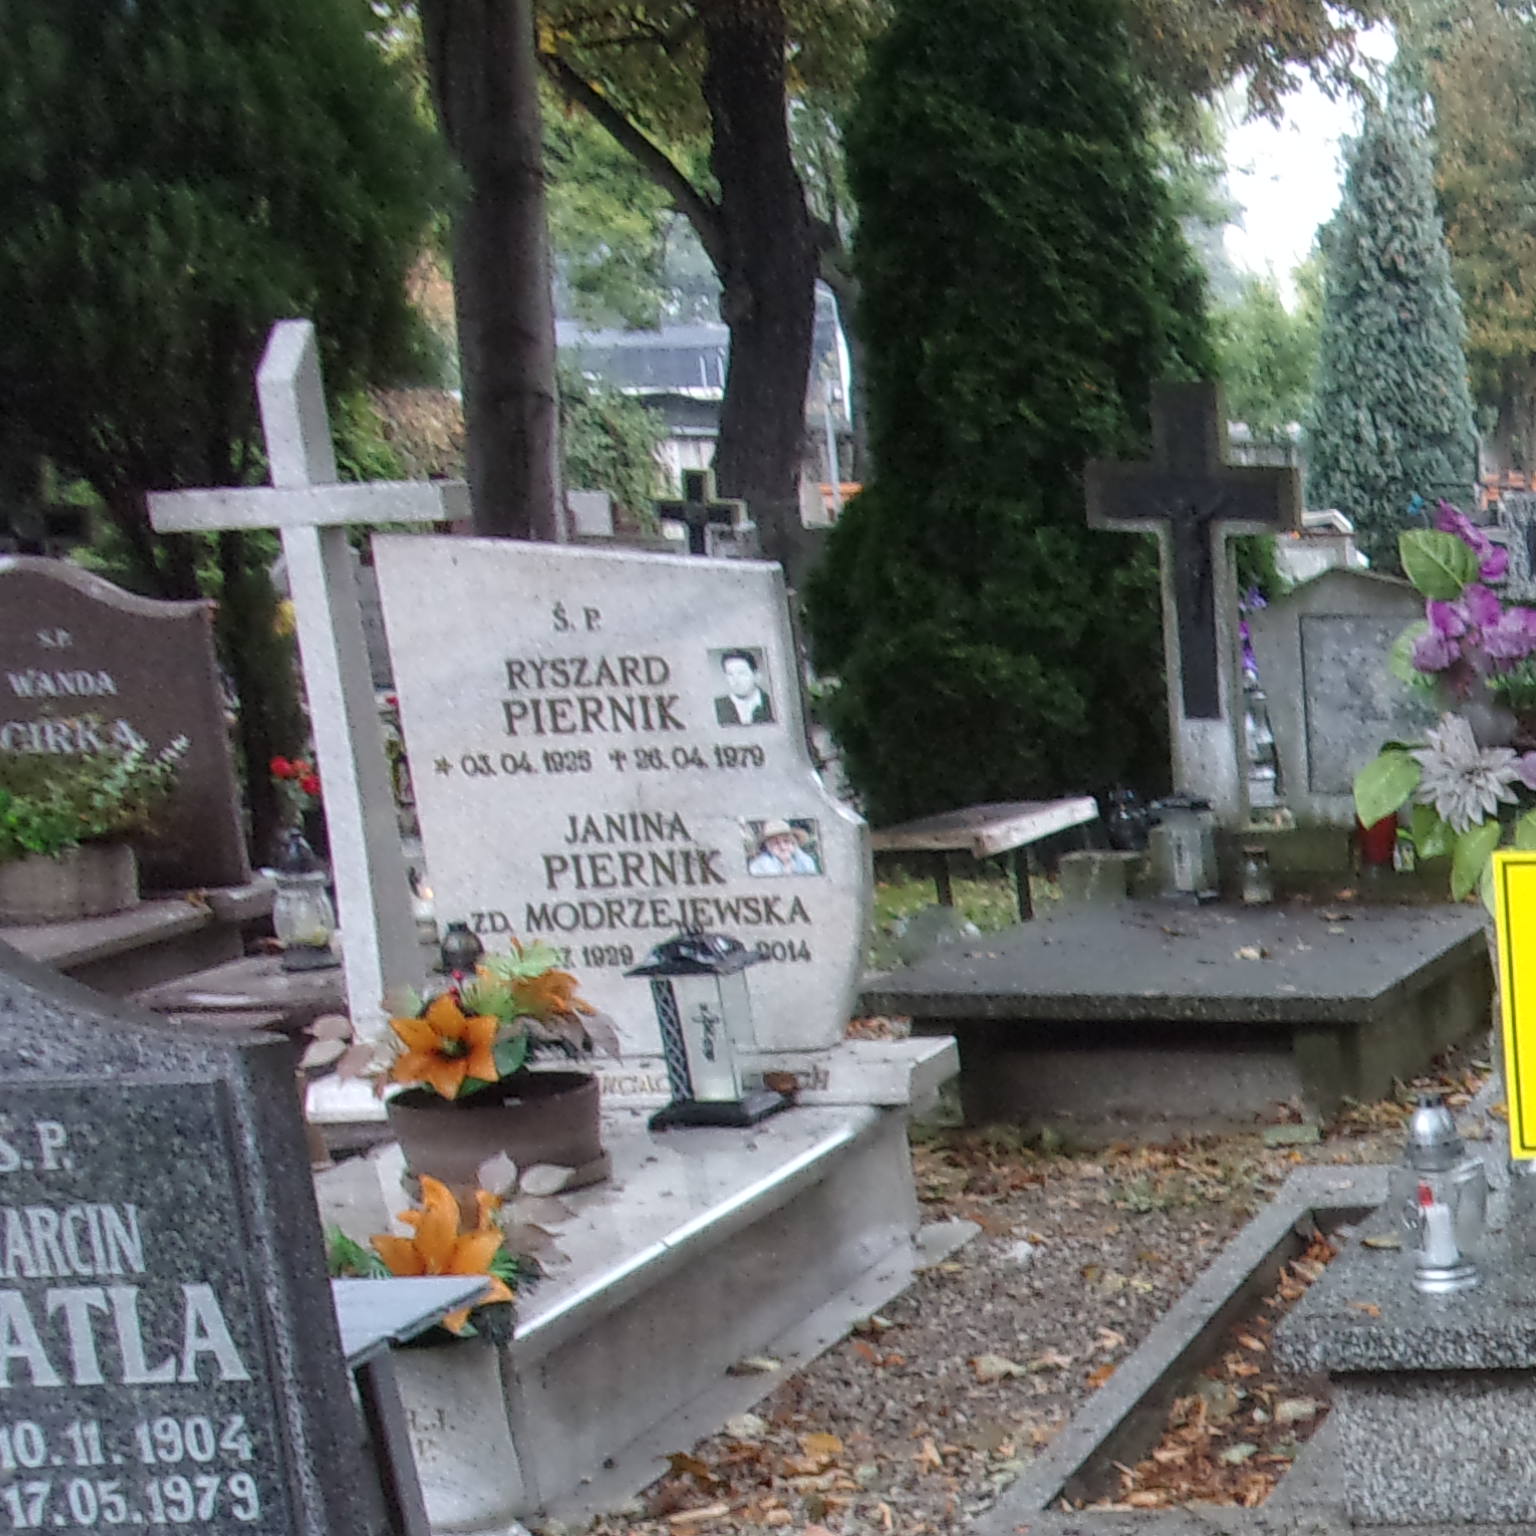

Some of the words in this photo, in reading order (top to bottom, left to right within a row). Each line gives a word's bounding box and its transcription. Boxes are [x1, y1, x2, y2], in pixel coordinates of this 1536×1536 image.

[7, 669, 118, 698] WANDA
[505, 655, 672, 691] RYSZARD
[501, 695, 687, 737] PIERNIK
[564, 811, 693, 845] JANINA
[542, 848, 728, 890] PIERNIK
[525, 896, 813, 934] MODRZEJEWSKA
[0, 1203, 146, 1278] ARCIN
[0, 1281, 252, 1389] ATLA
